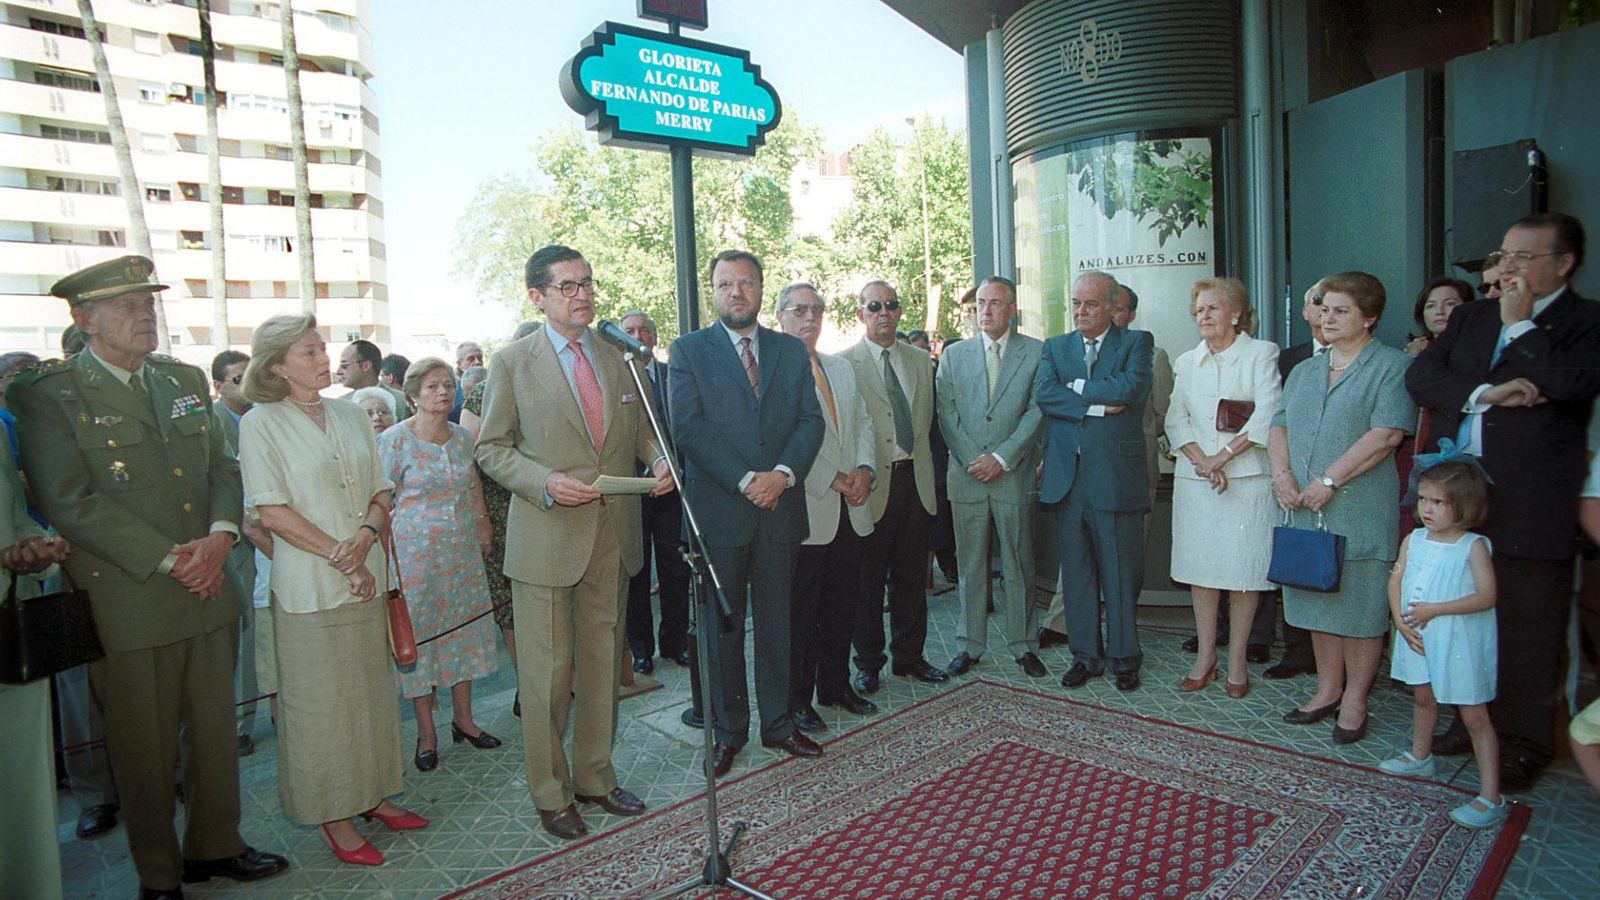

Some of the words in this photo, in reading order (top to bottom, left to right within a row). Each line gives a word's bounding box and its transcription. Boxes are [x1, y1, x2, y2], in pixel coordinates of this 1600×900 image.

[639, 48, 722, 77] GLORIETA
[643, 69, 721, 95] ALCALDE
[591, 79, 685, 109] FERNANDO
[688, 96, 710, 113] DE
[712, 99, 767, 122] PARIAS
[655, 110, 713, 132] MERRY
